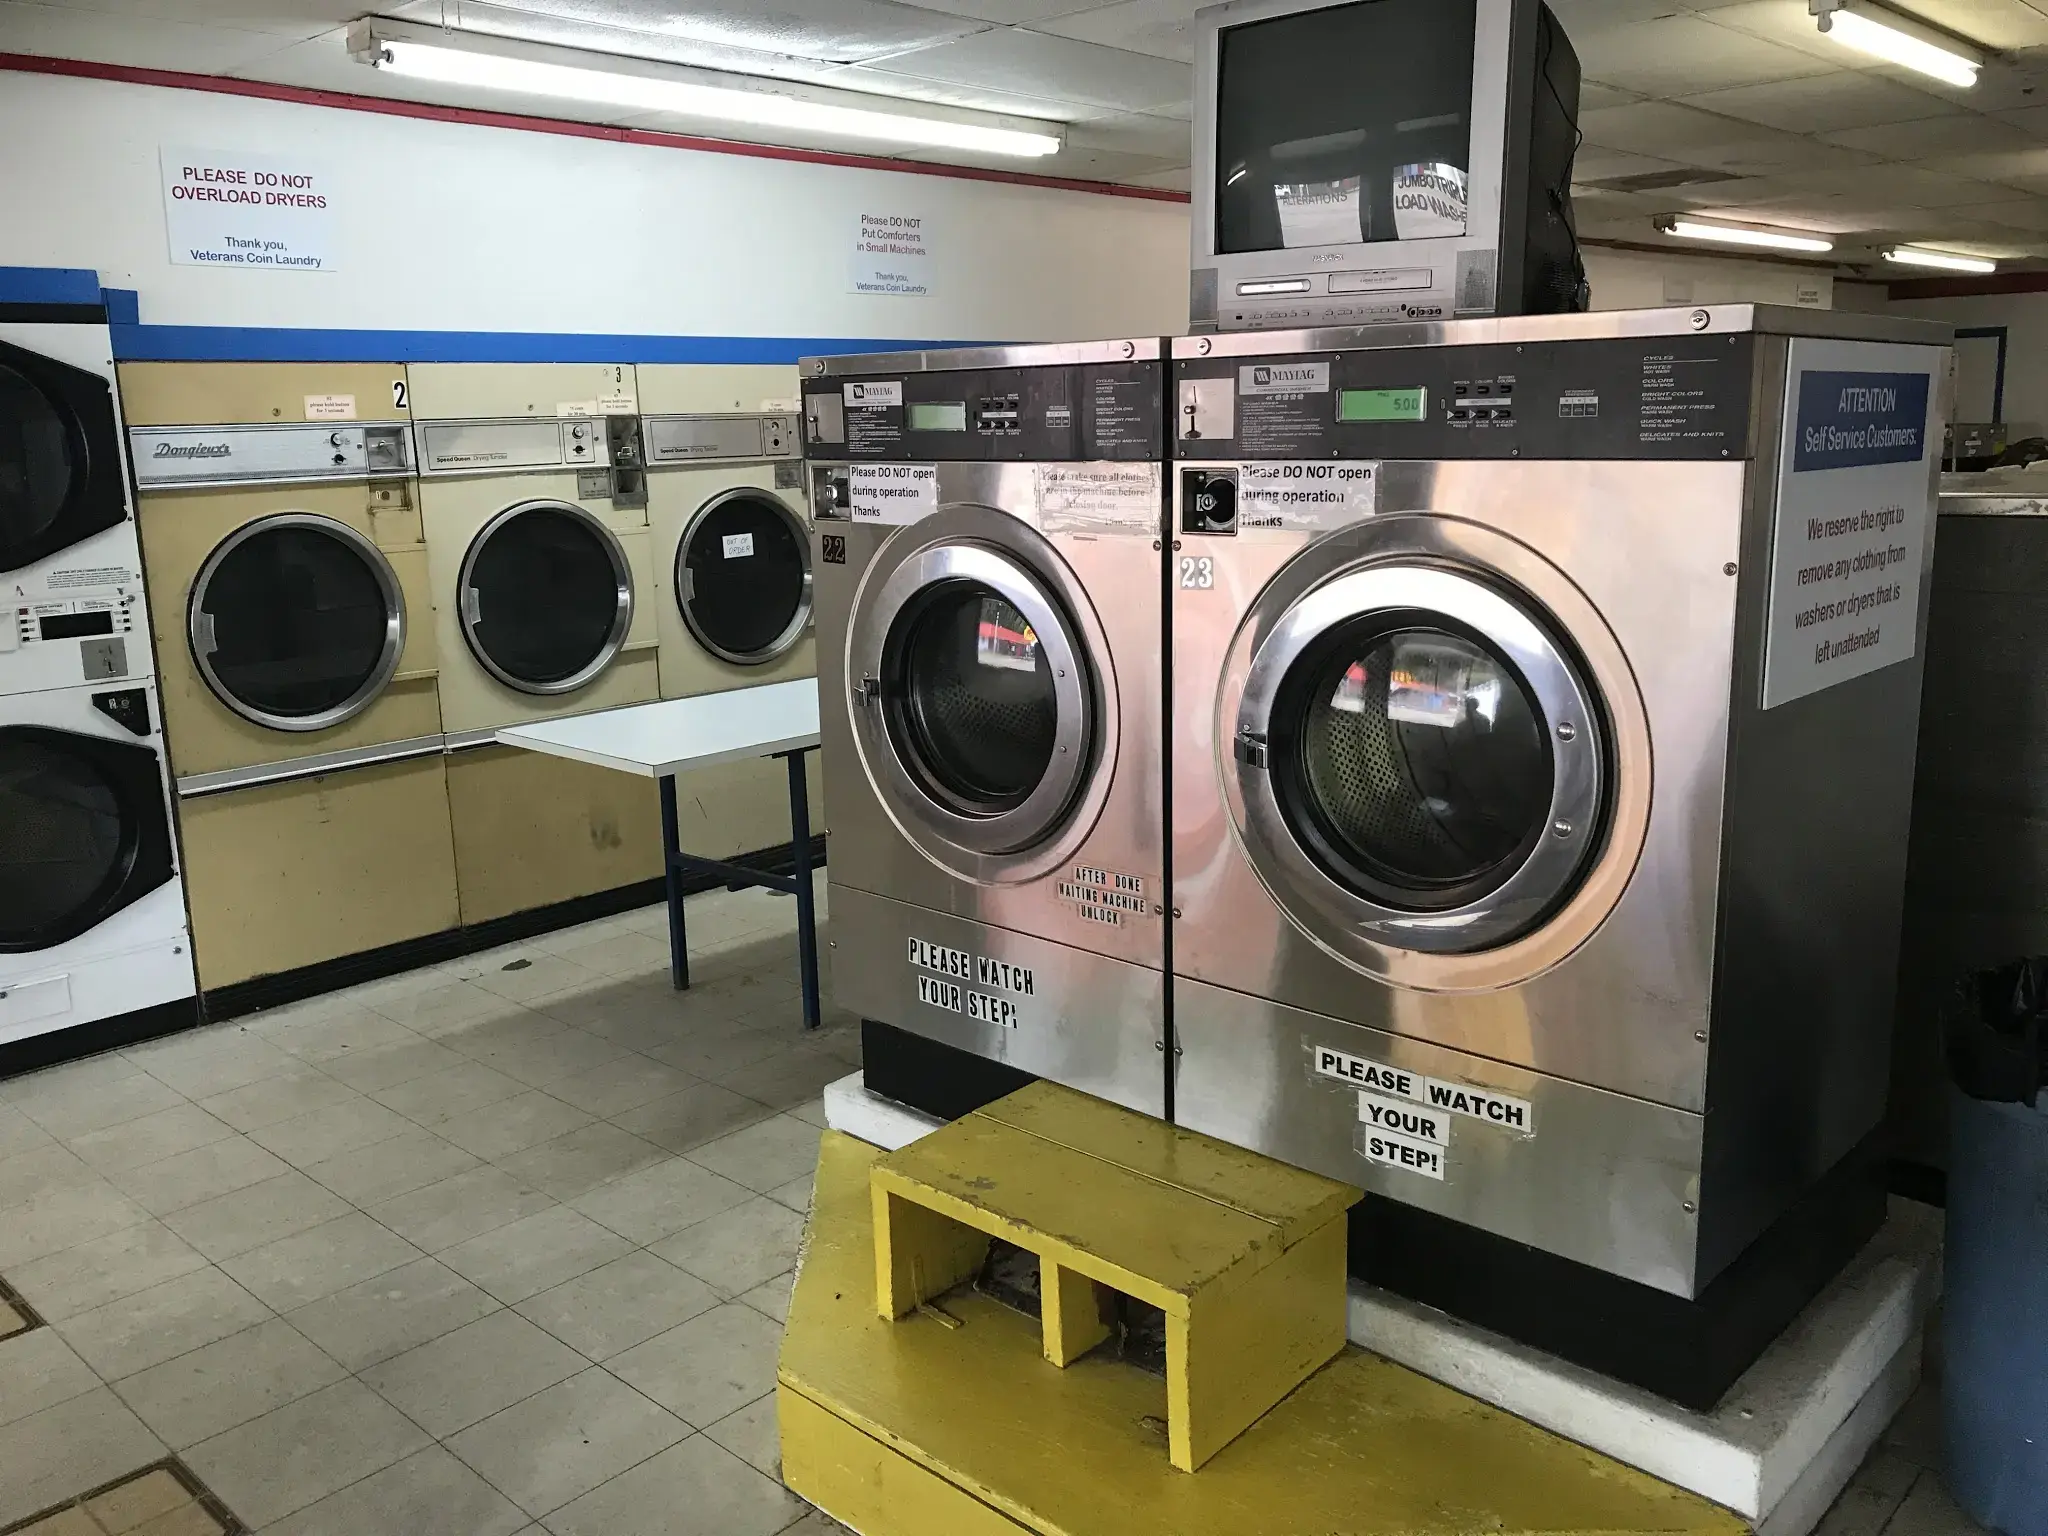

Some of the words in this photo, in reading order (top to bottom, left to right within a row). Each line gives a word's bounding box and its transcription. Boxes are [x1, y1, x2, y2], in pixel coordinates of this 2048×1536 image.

[183, 167, 247, 184] PLEASE
[254, 172, 278, 186] DO
[281, 174, 313, 189] NOT
[1398, 174, 1435, 190] JUMBO
[172, 185, 261, 204] OVERLOAD
[265, 192, 327, 208] DRYERS
[1282, 192, 1348, 206] ALTERATIONS
[1395, 193, 1428, 211] LOAD
[861, 214, 888, 226] Please
[889, 216, 903, 227] DO
[904, 218, 921, 228] NOT
[225, 236, 261, 249] Thank
[263, 240, 288, 252] you,
[862, 228, 876, 239] Put
[877, 229, 921, 242] Comforters
[856, 242, 865, 252] in
[866, 242, 888, 253] Small
[889, 244, 926, 256] Machines
[190, 249, 244, 263] Veterans
[246, 252, 273, 264] Coin
[275, 253, 321, 268] Laundry
[875, 272, 895, 281] Thank
[895, 275, 909, 283] you,
[856, 282, 885, 291] Veterans
[886, 283, 901, 292] Coin
[901, 284, 927, 295] Laundry
[615, 366, 622, 383] 3
[1272, 369, 1315, 381] MAYTAG
[393, 381, 407, 408] 2
[865, 387, 893, 396] MAYTAG
[1838, 387, 1897, 413] ATTENTION
[1393, 397, 1419, 411] 5.00
[1805, 425, 1828, 453] Self
[1827, 425, 1866, 451] Service
[1867, 423, 1918, 448] Customers:
[851, 466, 876, 478] Please
[878, 467, 891, 478] DO
[893, 467, 911, 478] NOT
[912, 470, 935, 481] open
[1089, 473, 1107, 481] sure
[1109, 472, 1119, 481] all
[1242, 464, 1280, 479] Please
[1283, 465, 1303, 478] DO
[1305, 465, 1335, 479] NOT
[1337, 468, 1372, 482] open
[852, 485, 877, 499] during
[879, 487, 919, 499] operation
[1118, 487, 1145, 497] before
[1241, 488, 1280, 505] during
[1282, 489, 1345, 505] operation
[853, 505, 880, 517] Thanks
[1241, 513, 1283, 527] Thanks
[1807, 517, 1823, 541] We
[1825, 515, 1859, 538] reserve
[1860, 509, 1875, 531] the
[1875, 504, 1896, 532] right
[1896, 503, 1905, 524] to
[726, 537, 738, 546] OUT
[740, 536, 749, 545] OF
[728, 545, 751, 555] ORDER
[823, 536, 845, 562] 22
[1181, 557, 1213, 589] 23
[1797, 561, 1834, 586] remove
[1834, 558, 1853, 580] any
[1852, 547, 1887, 572] clothing
[1887, 543, 1906, 565] from
[1795, 602, 1835, 630] washers
[1836, 599, 1848, 617] or
[1847, 592, 1876, 617] dryers
[1876, 583, 1893, 606] that
[1893, 581, 1901, 601] is
[1814, 640, 1831, 665] left
[1831, 624, 1881, 658] unattended
[1075, 867, 1106, 885] AFTER
[1115, 874, 1141, 892] DONE
[1058, 882, 1098, 903] WAITING
[1102, 891, 1145, 913] MACHINE
[1081, 904, 1118, 925] UNLOCK
[910, 938, 969, 979] PLEASE
[979, 957, 1034, 996] WATCH
[919, 976, 960, 1012] YOUR
[1321, 1052, 1412, 1096] PLEASE
[1429, 1084, 1523, 1126] WATCH
[1367, 1103, 1437, 1139] YOUR
[1369, 1137, 1438, 1172] STEP!
